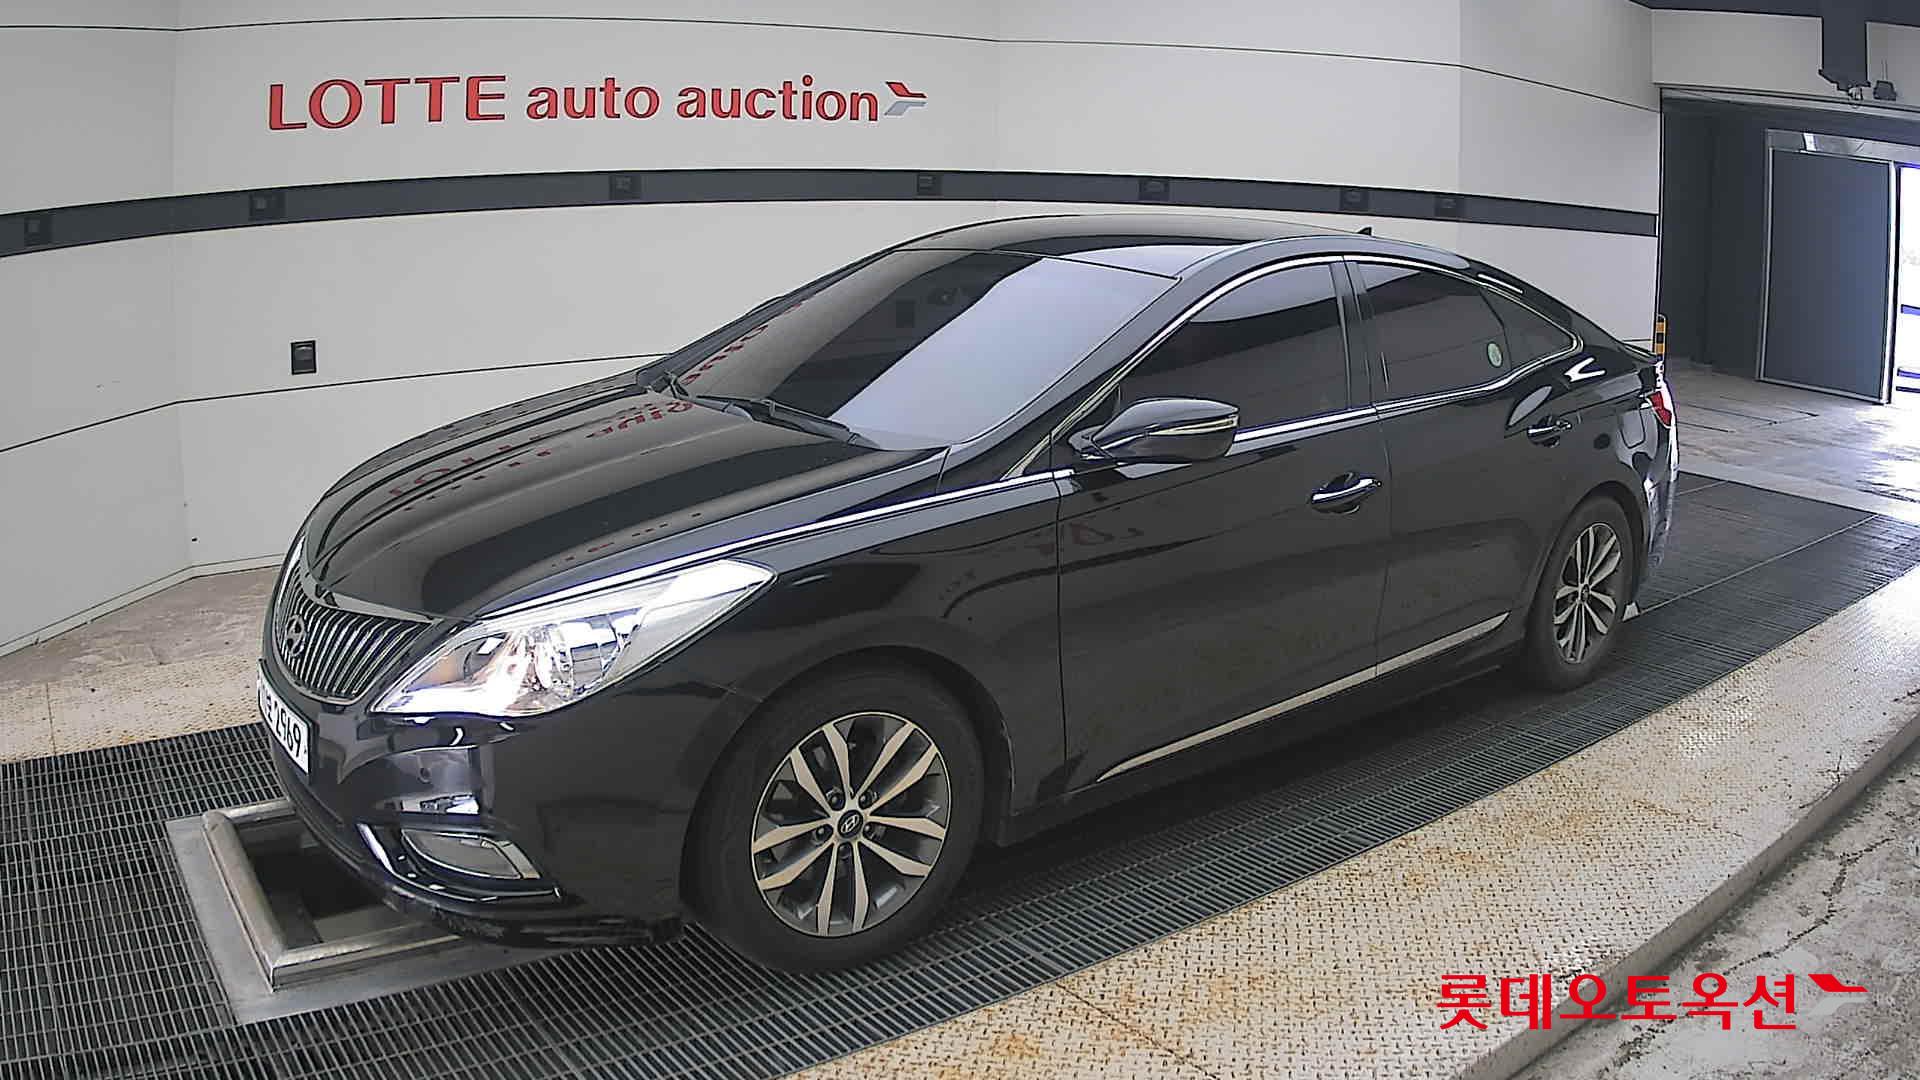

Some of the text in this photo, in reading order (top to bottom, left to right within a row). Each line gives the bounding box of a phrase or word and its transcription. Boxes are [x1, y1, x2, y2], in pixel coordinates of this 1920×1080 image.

[269, 74, 879, 130] LOTTE auto auction
